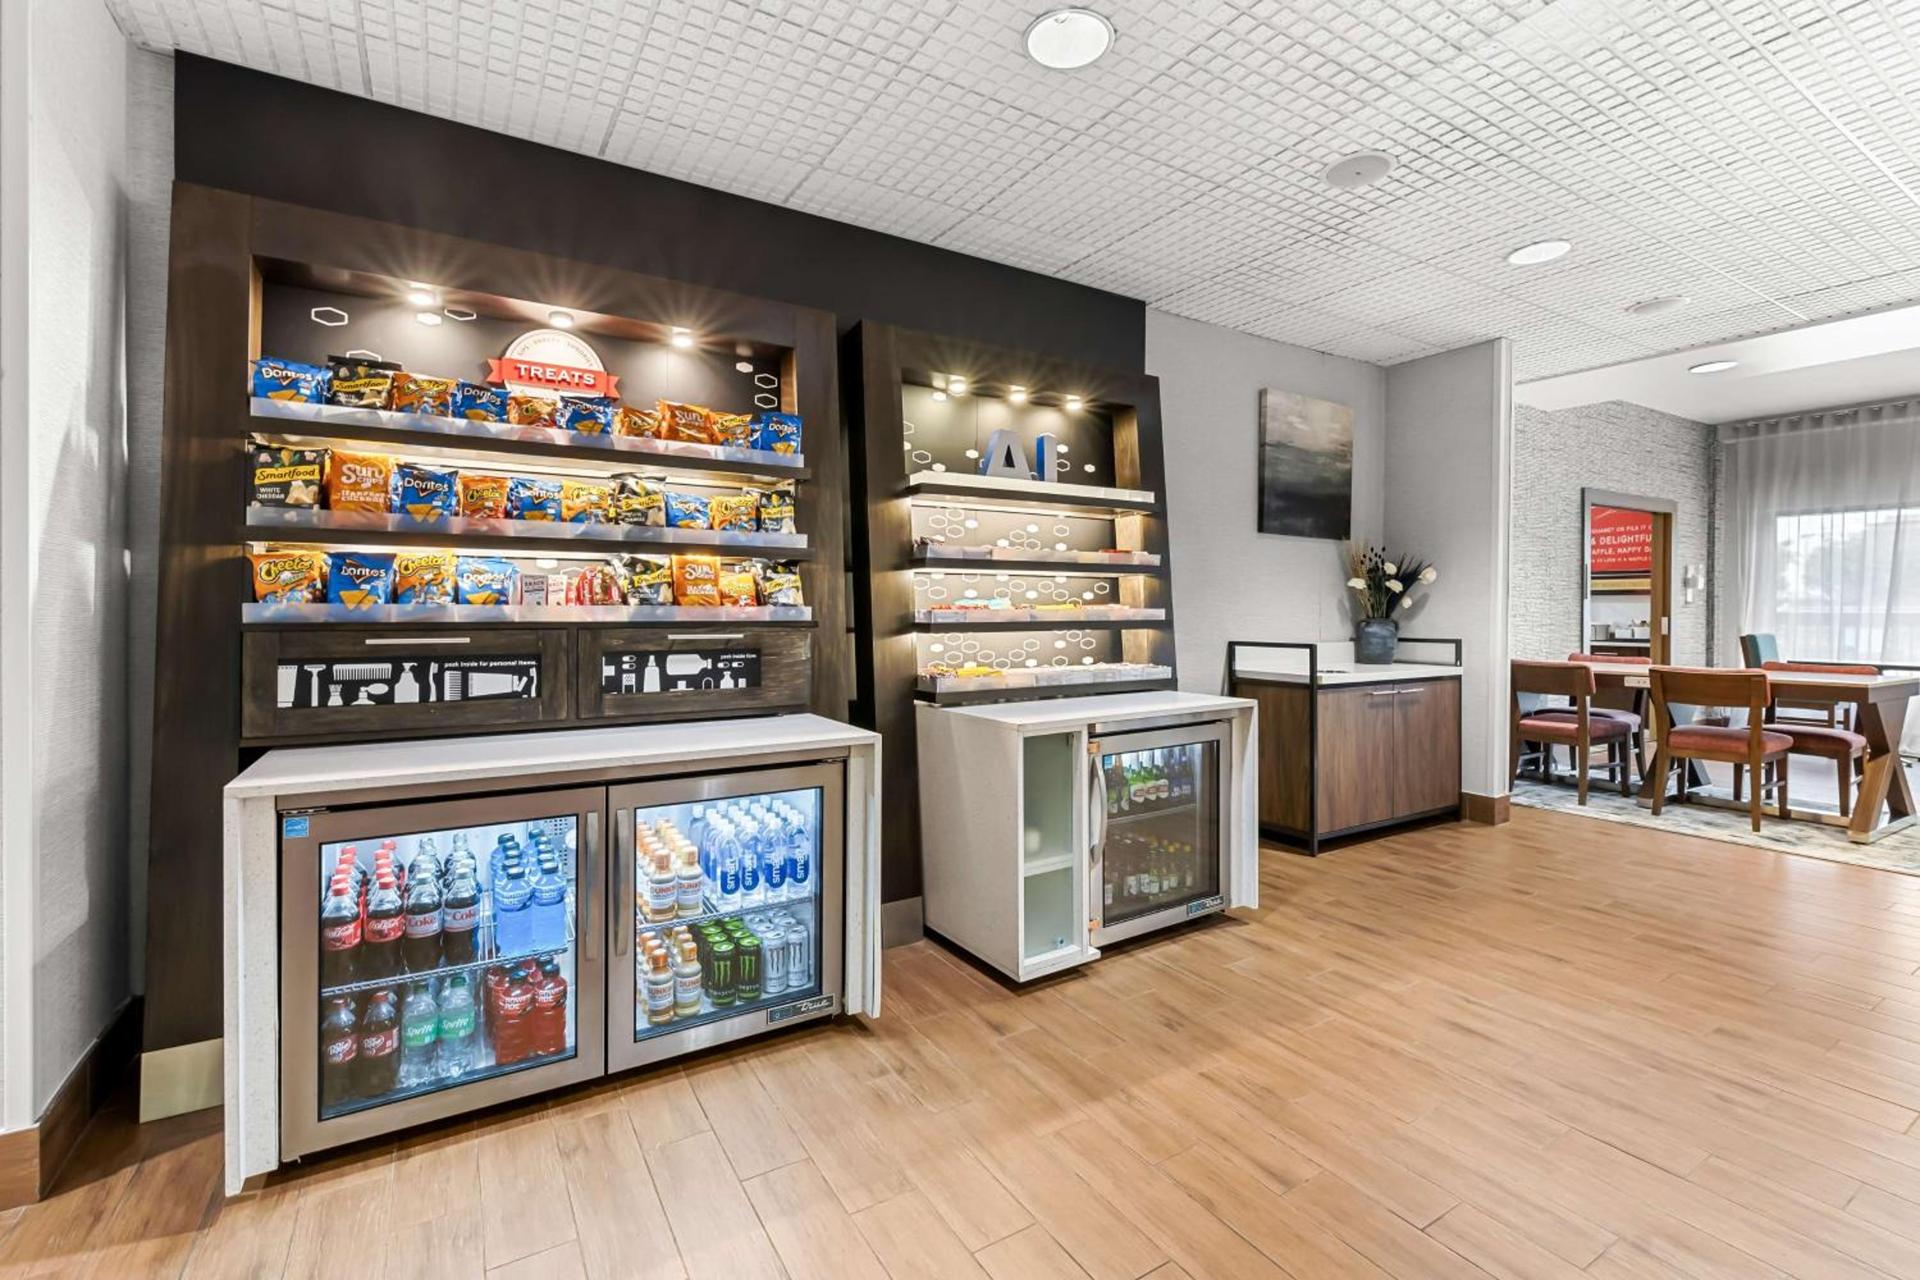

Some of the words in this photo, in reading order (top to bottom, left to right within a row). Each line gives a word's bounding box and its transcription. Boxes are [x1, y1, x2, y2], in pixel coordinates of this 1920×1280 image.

[261, 367, 313, 382] Doritos
[517, 364, 595, 385] TREATS
[257, 468, 316, 481] Smartfood
[341, 464, 385, 484] Sun
[405, 477, 449, 492] Doritos
[1599, 534, 1652, 545] DELIGHTFU
[1592, 547, 1615, 555] AFFLE,
[1617, 546, 1641, 554] HAPPY
[259, 558, 314, 583] Cheetos
[340, 566, 386, 579] Doritos
[400, 555, 446, 576] Cheetos
[489, 660, 518, 668] personal
[727, 856, 737, 890] smart
[408, 1023, 434, 1037] Sprite
[443, 1017, 469, 1031] Sprite
